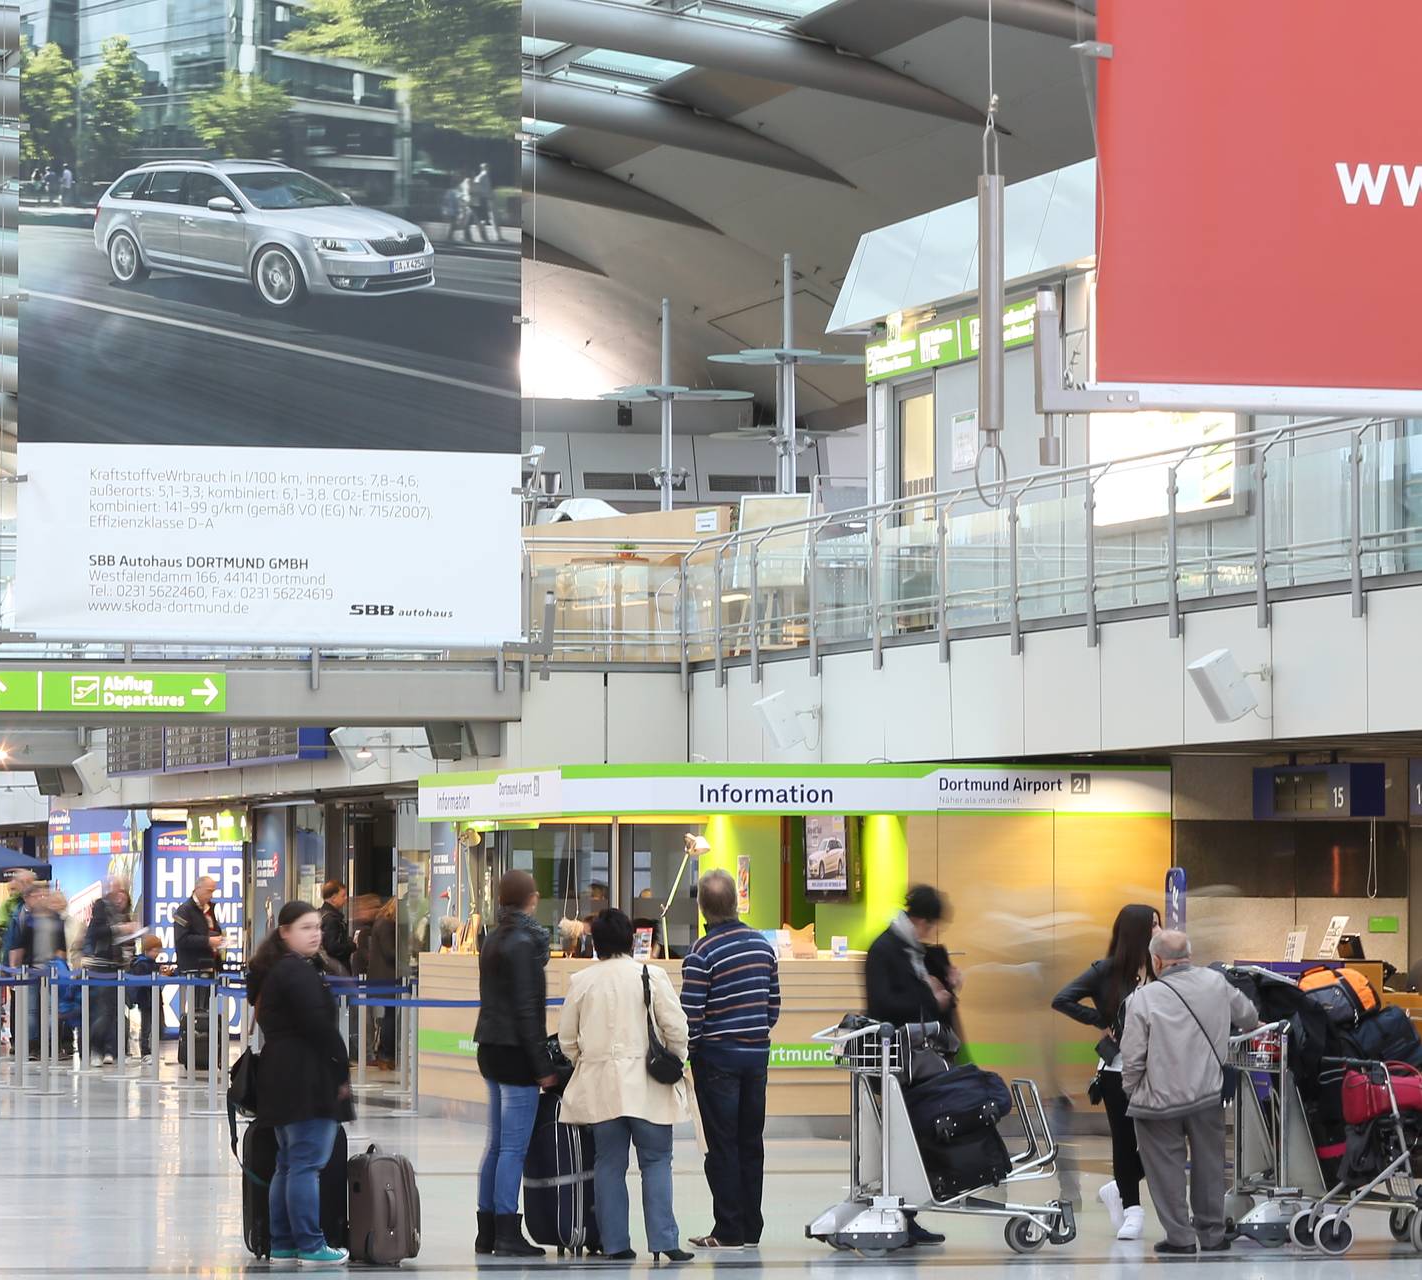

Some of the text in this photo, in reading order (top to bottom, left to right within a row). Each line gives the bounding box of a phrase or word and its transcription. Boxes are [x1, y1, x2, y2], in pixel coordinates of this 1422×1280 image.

[89, 468, 226, 483] KraftstoffveWrbrauch
[230, 471, 241, 483] in
[281, 472, 303, 486] km,
[306, 472, 367, 486] innerorts:
[89, 484, 154, 497] außerorts:
[208, 486, 278, 499] kombiniert:
[89, 500, 160, 513] kombiniert:
[211, 502, 243, 517] g/km
[247, 502, 294, 518] (gemäß
[298, 504, 316, 516] VO
[321, 504, 345, 519] (EG)
[349, 505, 365, 518] Nr.
[89, 515, 184, 529] Effizienzklasse
[89, 555, 308, 570] SBB Autohaus DORTMUND GMBH
[88, 569, 325, 585] Westfalendamm 166, 44141 Dortmund
[89, 585, 333, 600] Tel.: 0231 5622460, Fax: 0231 56224619
[88, 600, 249, 614] www.skoda-dortmund.de
[349, 604, 453, 618] SBB autohaus
[103, 676, 153, 694] Abflug
[103, 692, 185, 709] Departures
[700, 783, 834, 804] Information
[939, 777, 1009, 792] Dortmund
[1013, 777, 1063, 795] Airport
[437, 791, 471, 810] Information
[1332, 787, 1344, 808] 15
[156, 857, 243, 898] HIER
